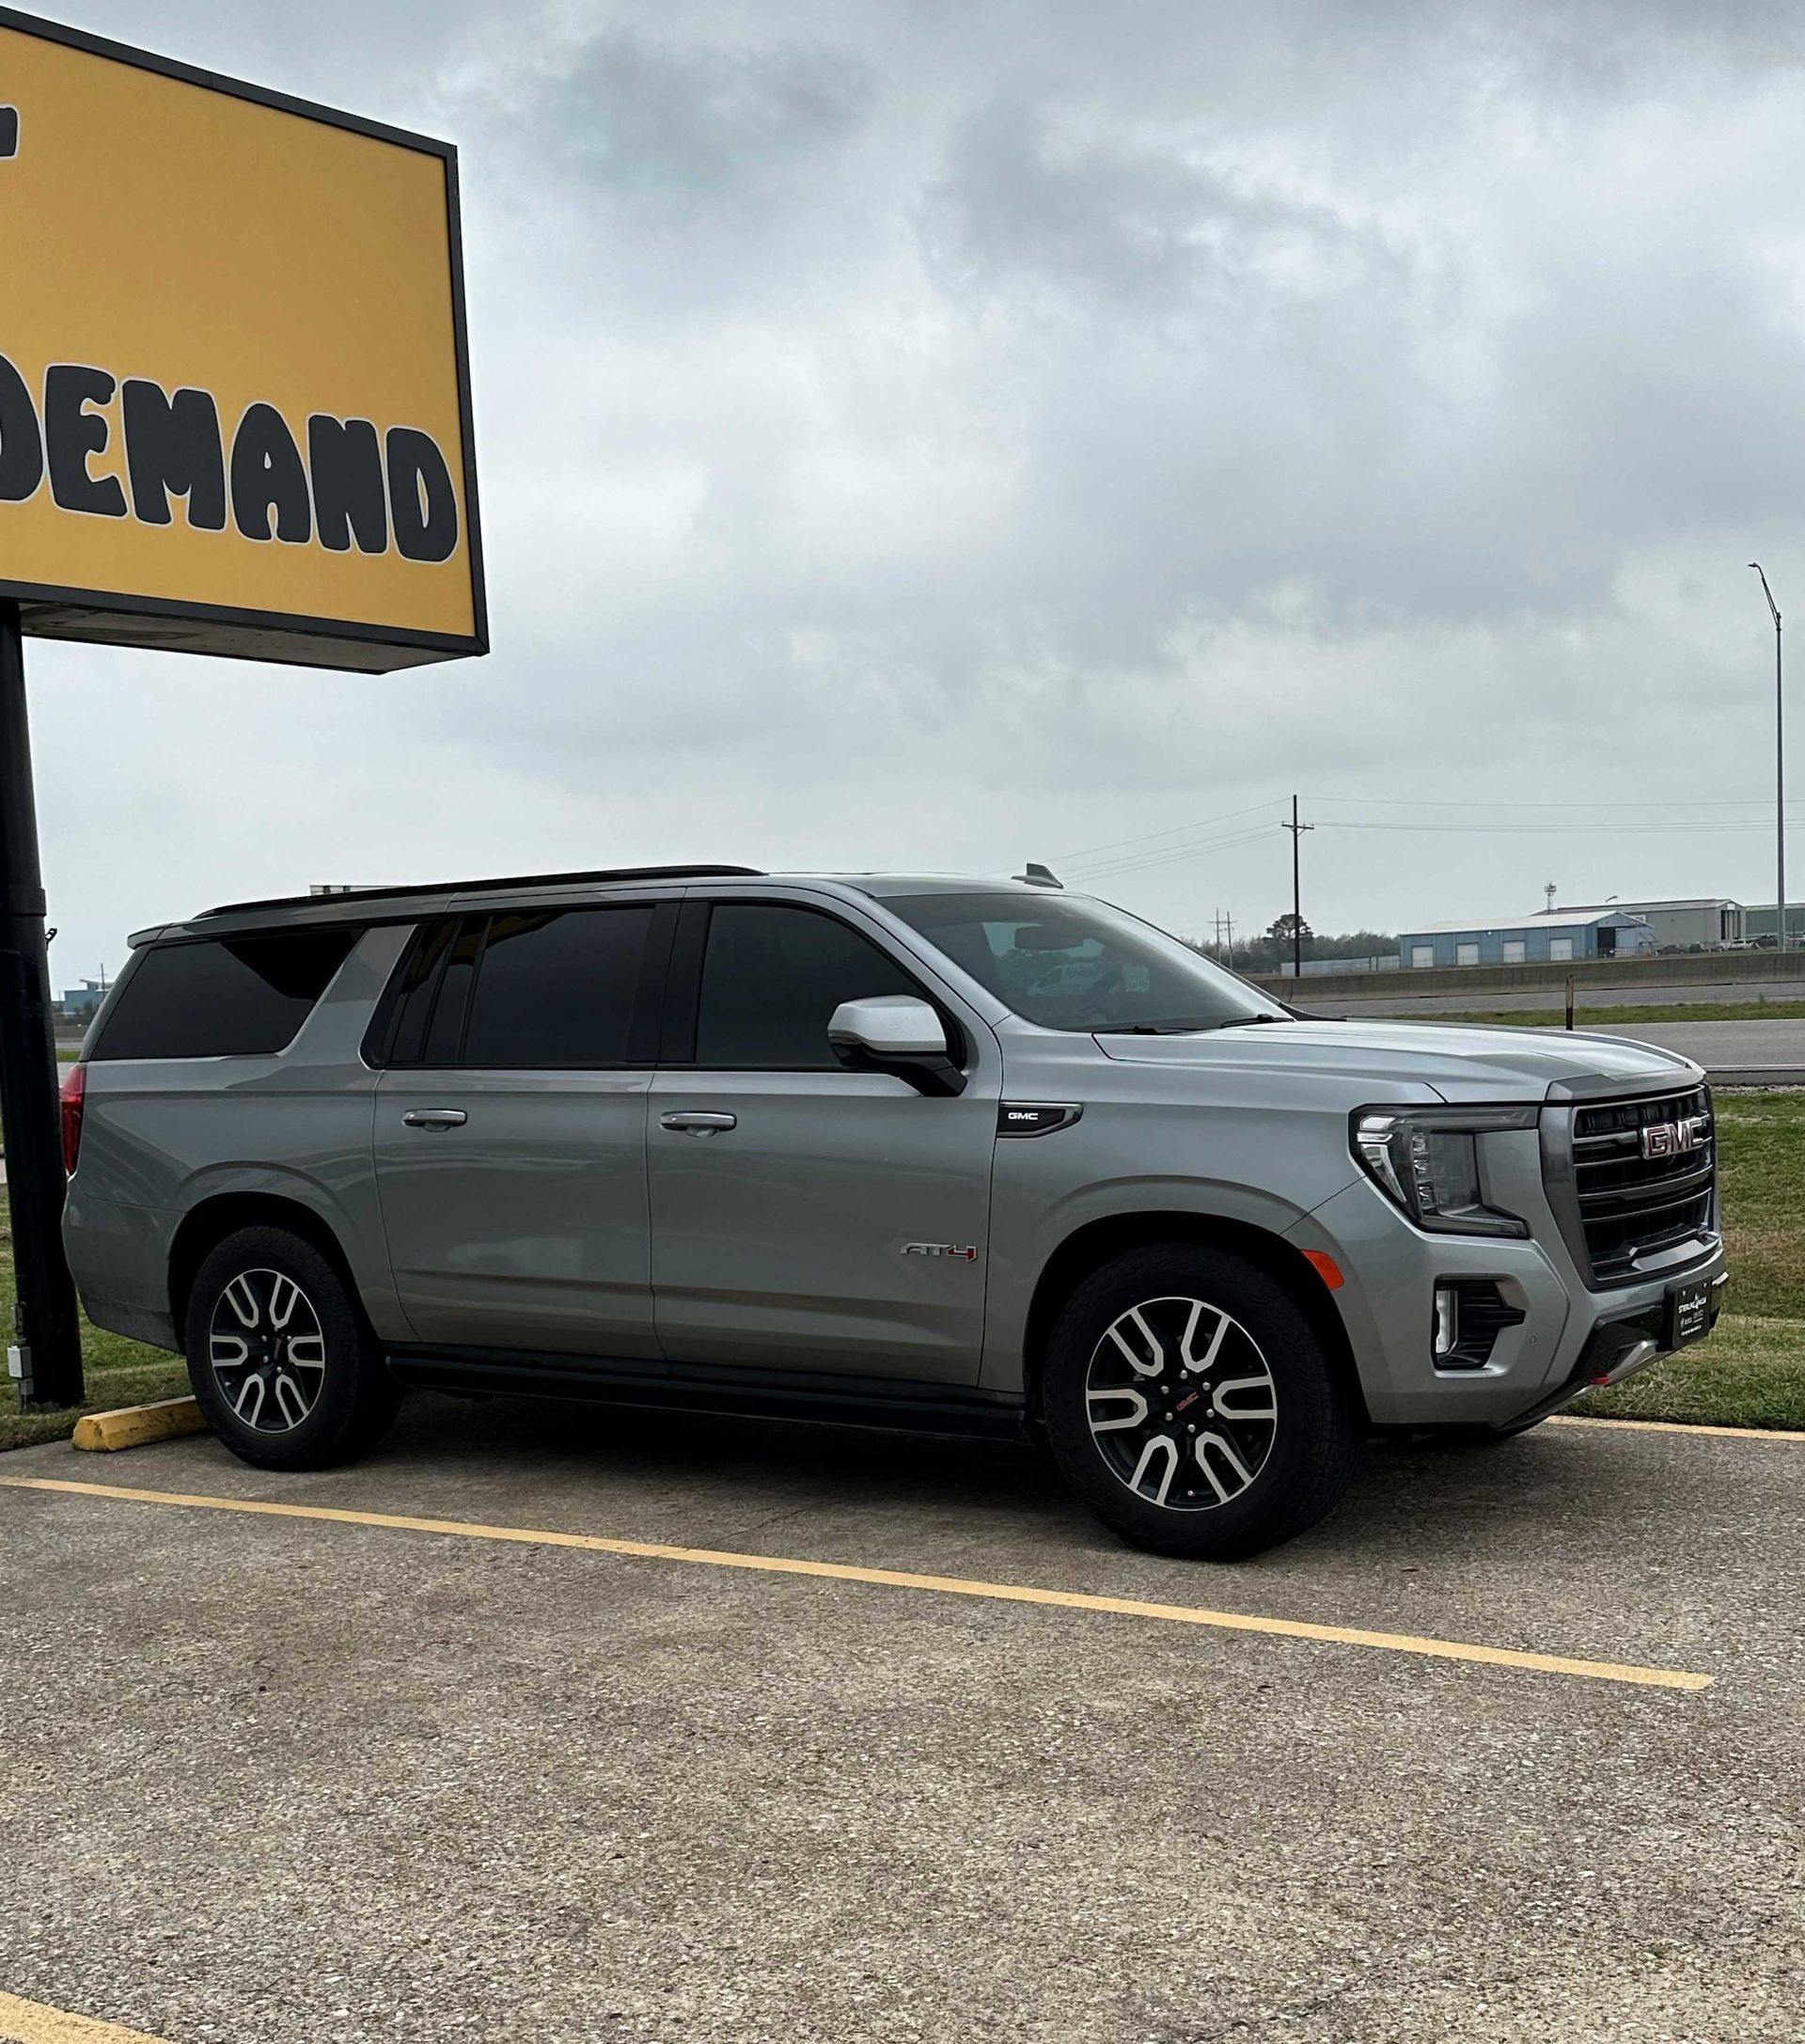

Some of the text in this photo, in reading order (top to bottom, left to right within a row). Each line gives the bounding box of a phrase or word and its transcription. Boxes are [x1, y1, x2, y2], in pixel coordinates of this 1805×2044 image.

[1008, 1112, 1039, 1121] GMC
[1642, 1116, 1704, 1159] GMC
[901, 1242, 977, 1263] AT4
